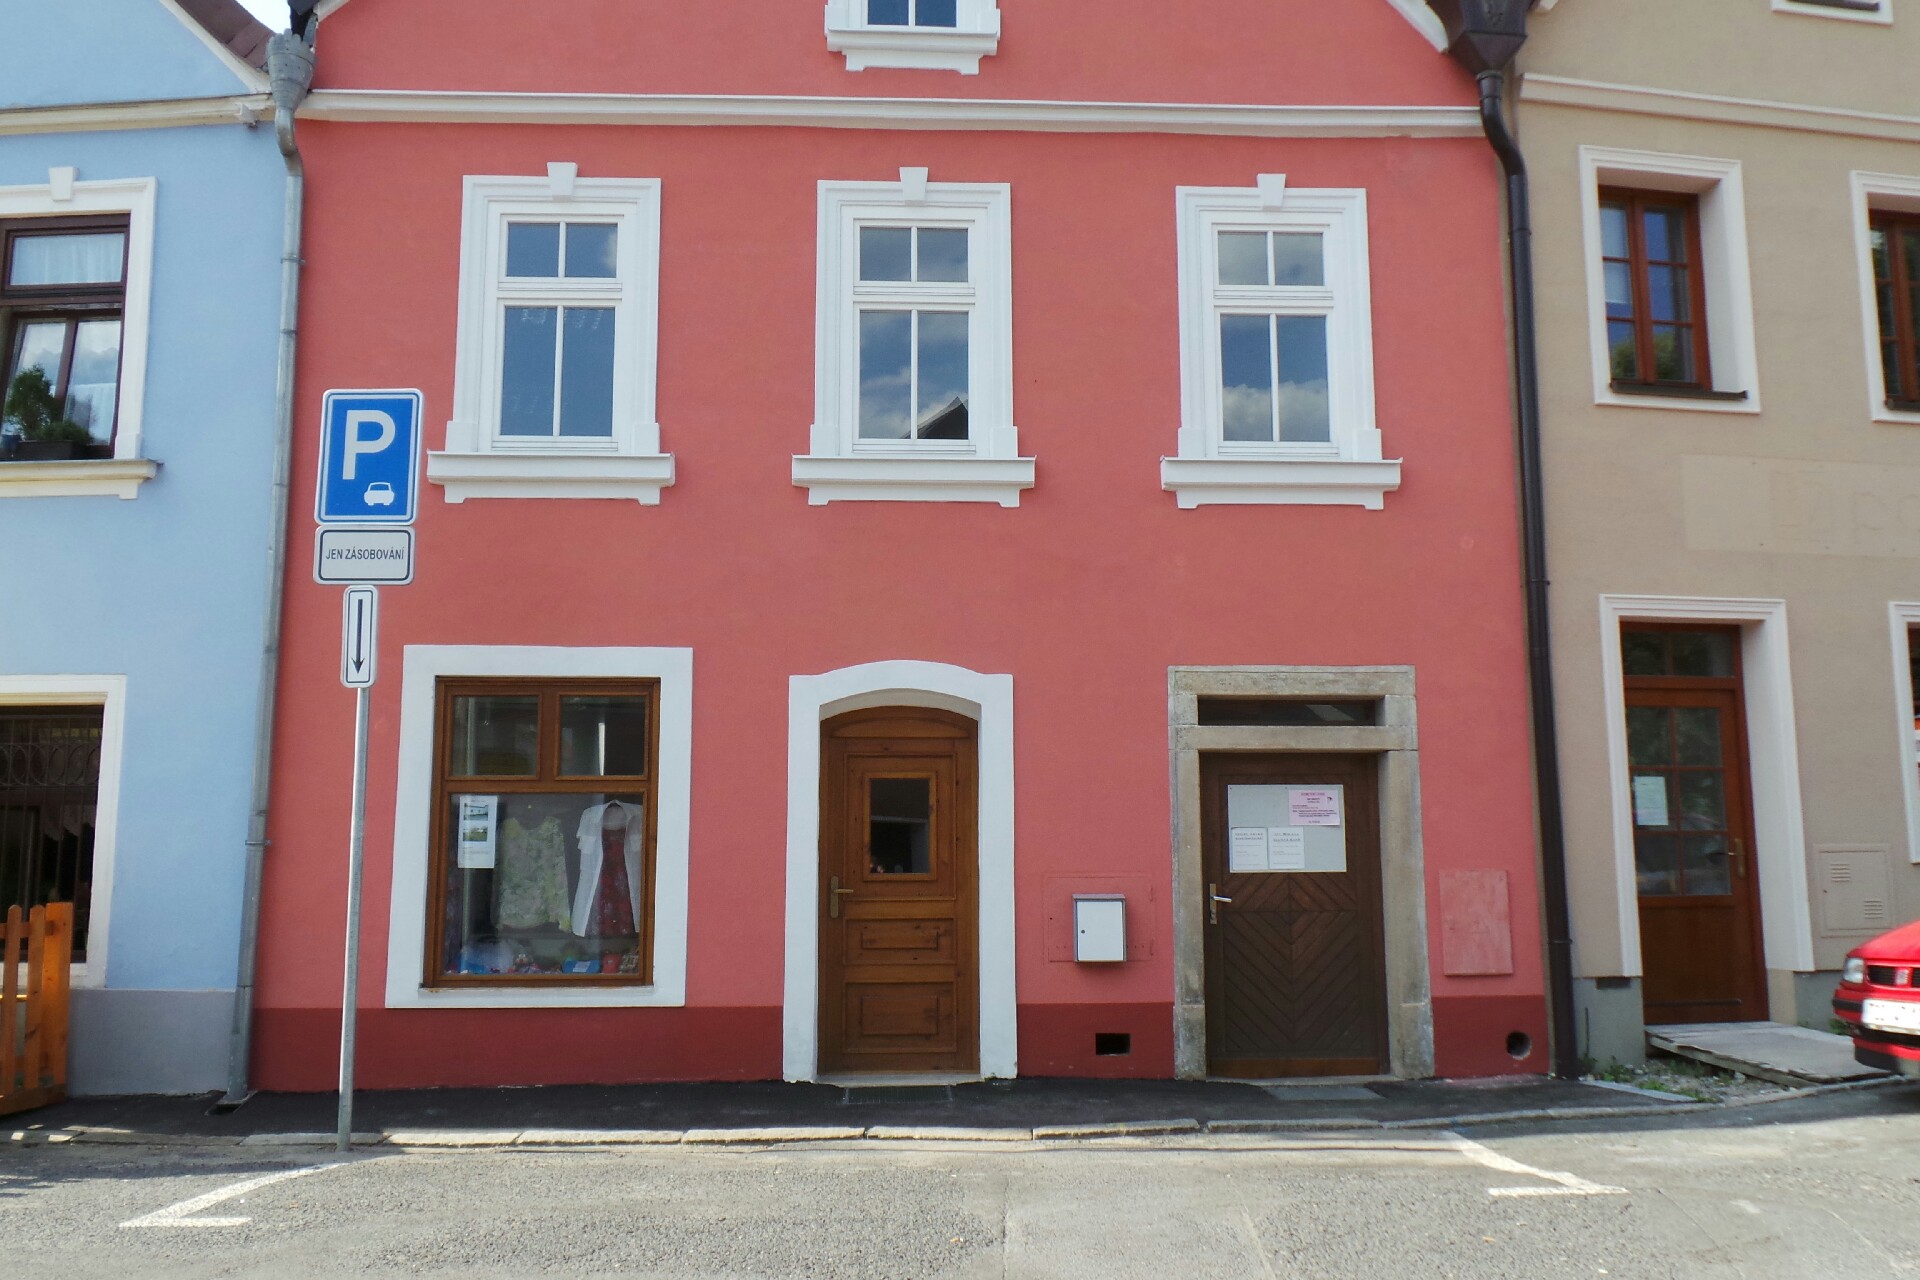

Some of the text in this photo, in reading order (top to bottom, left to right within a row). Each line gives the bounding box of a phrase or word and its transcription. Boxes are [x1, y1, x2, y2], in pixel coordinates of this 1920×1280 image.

[342, 410, 396, 480] P
[326, 546, 405, 560] JEN ZÁSOBOVÁNÍ
